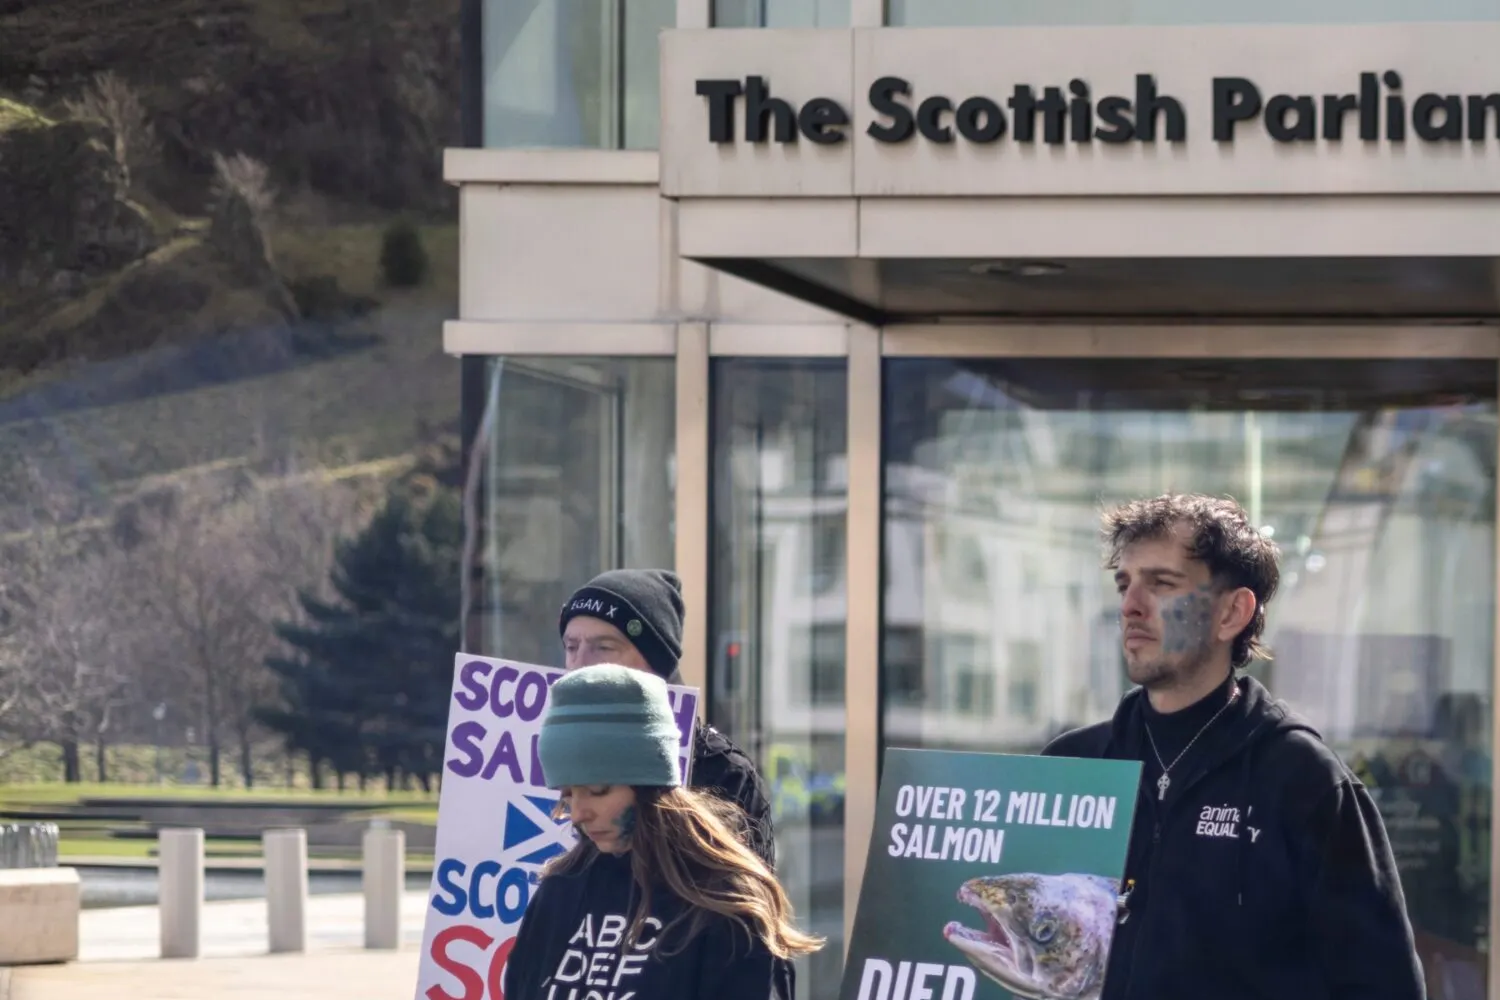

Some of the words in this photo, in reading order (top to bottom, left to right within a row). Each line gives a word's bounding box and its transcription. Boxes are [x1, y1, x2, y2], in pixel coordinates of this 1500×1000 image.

[695, 75, 853, 143] The
[866, 73, 1187, 144] Scottish
[606, 605, 618, 618] X
[895, 784, 967, 821] OVER
[973, 789, 1001, 823] 12
[1005, 791, 1117, 830] MILLION
[888, 822, 1005, 864] SALMON
[568, 912, 663, 952] ABC
[554, 948, 649, 988] DEF
